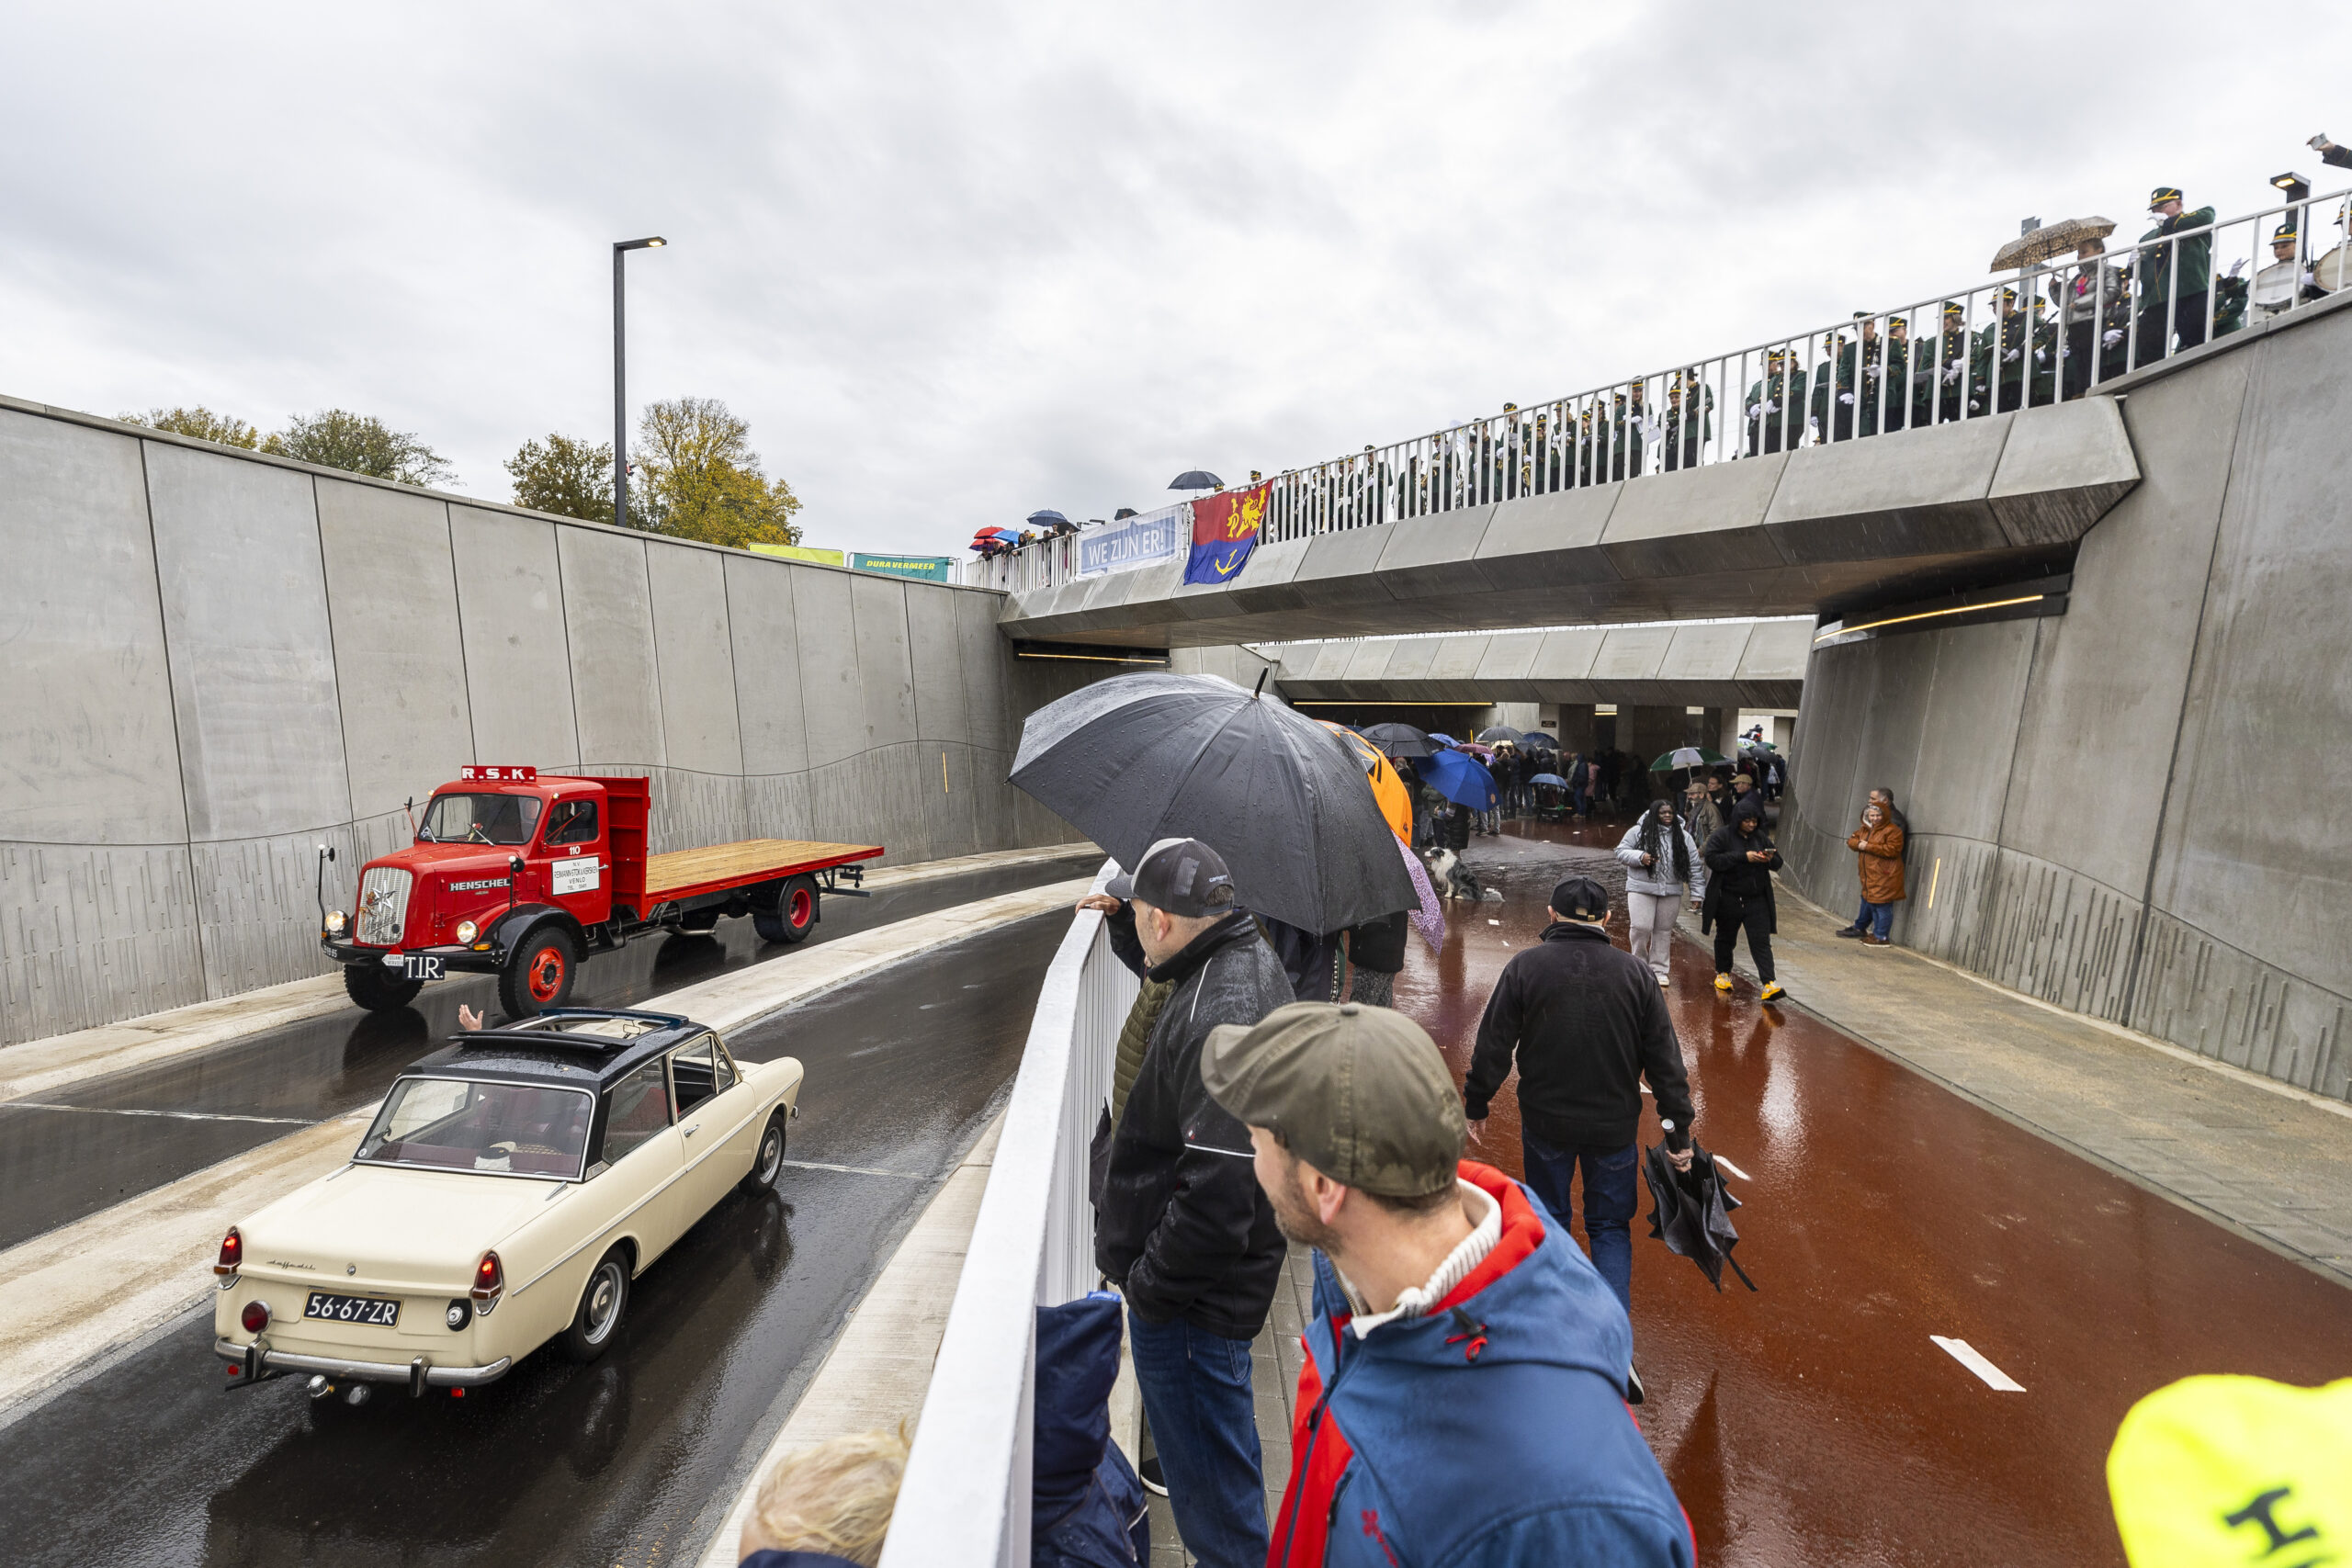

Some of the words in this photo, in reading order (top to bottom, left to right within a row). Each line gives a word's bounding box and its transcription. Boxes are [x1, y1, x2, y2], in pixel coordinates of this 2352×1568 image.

[1089, 542, 1108, 567] WE
[1110, 534, 1139, 563] ZIJN
[1142, 527, 1164, 555] ER!
[892, 561, 935, 570] VERMEER
[461, 768, 535, 780] R.S.K.
[569, 845, 581, 855] 110
[450, 878, 511, 892] HENSCHEL
[569, 876, 585, 885] VENLO
[308, 1295, 396, 1324] 56-67-ZR
